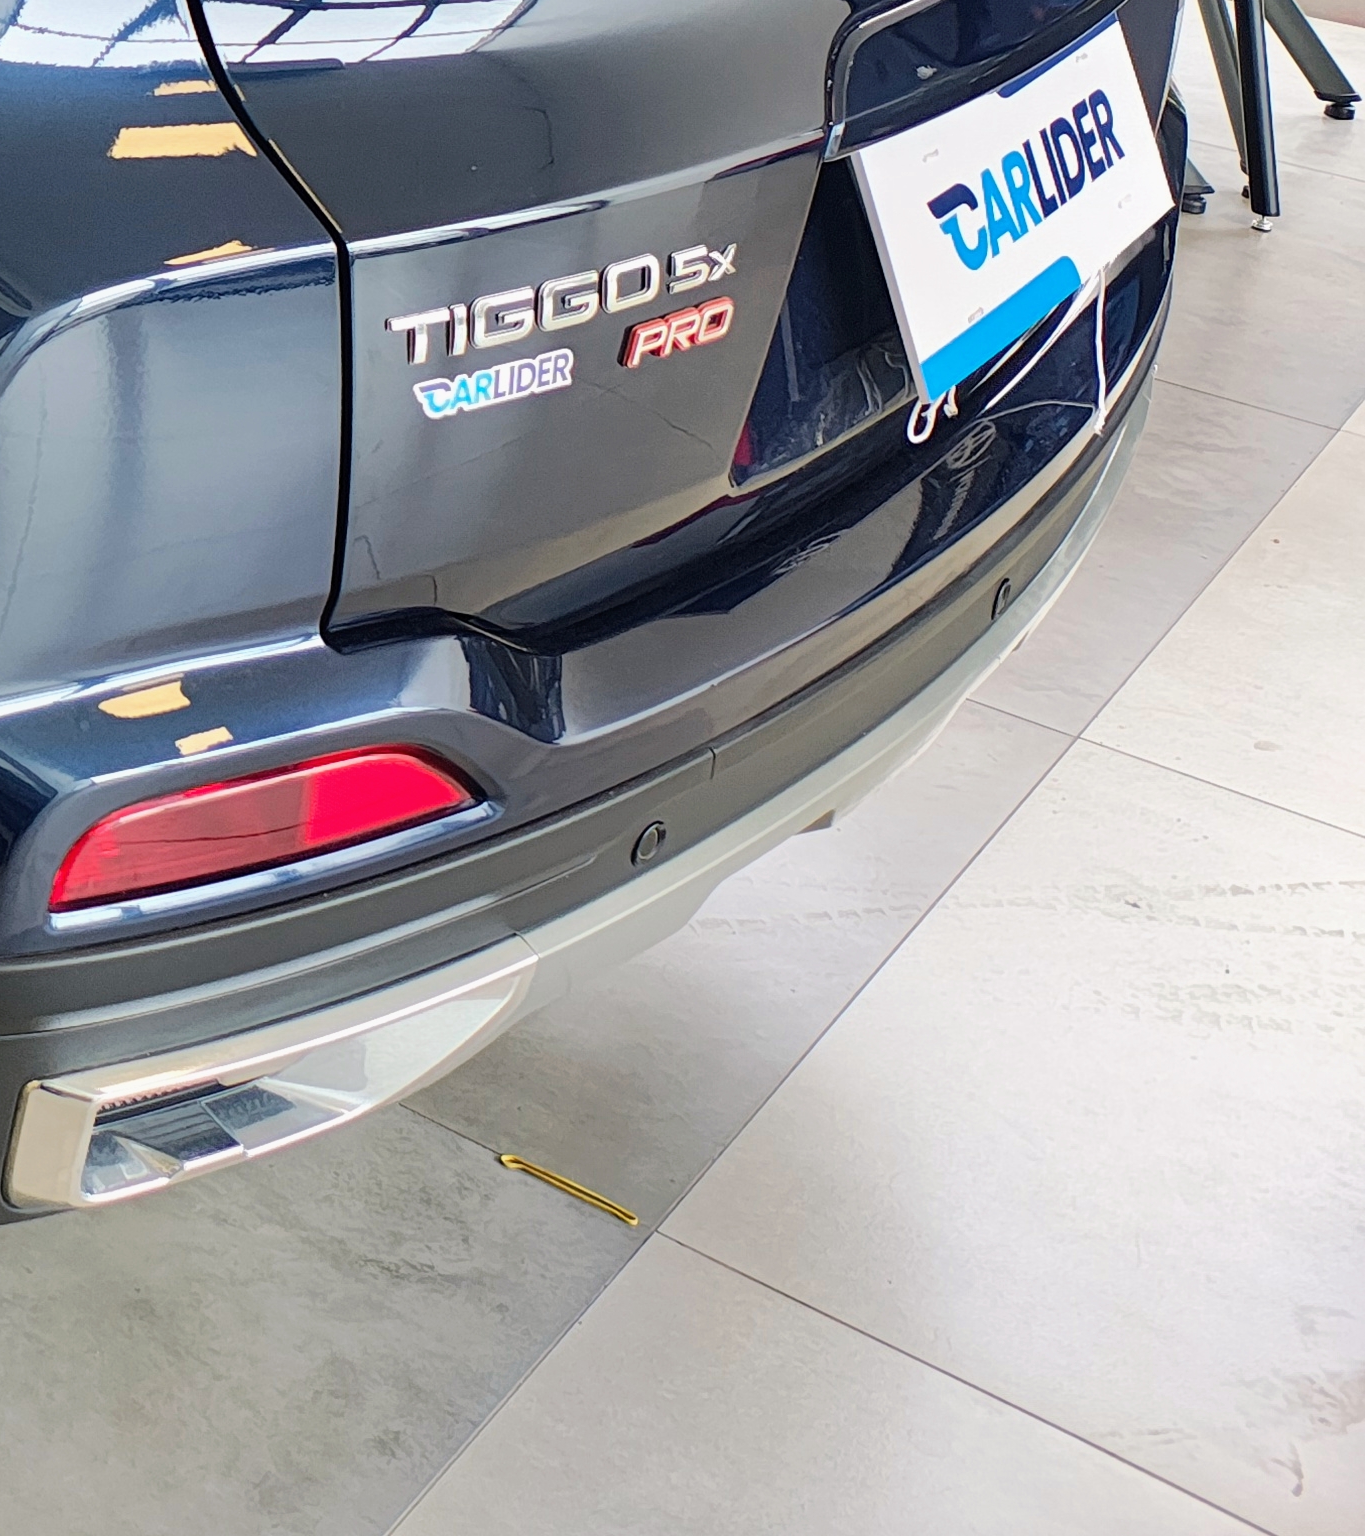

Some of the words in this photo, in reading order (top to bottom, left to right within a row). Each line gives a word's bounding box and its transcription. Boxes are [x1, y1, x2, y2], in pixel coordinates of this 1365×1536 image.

[926, 88, 1126, 271] CARLIDER
[384, 252, 661, 365] TIGGO
[620, 296, 735, 369] PRO
[417, 351, 572, 414] CARLIDER
